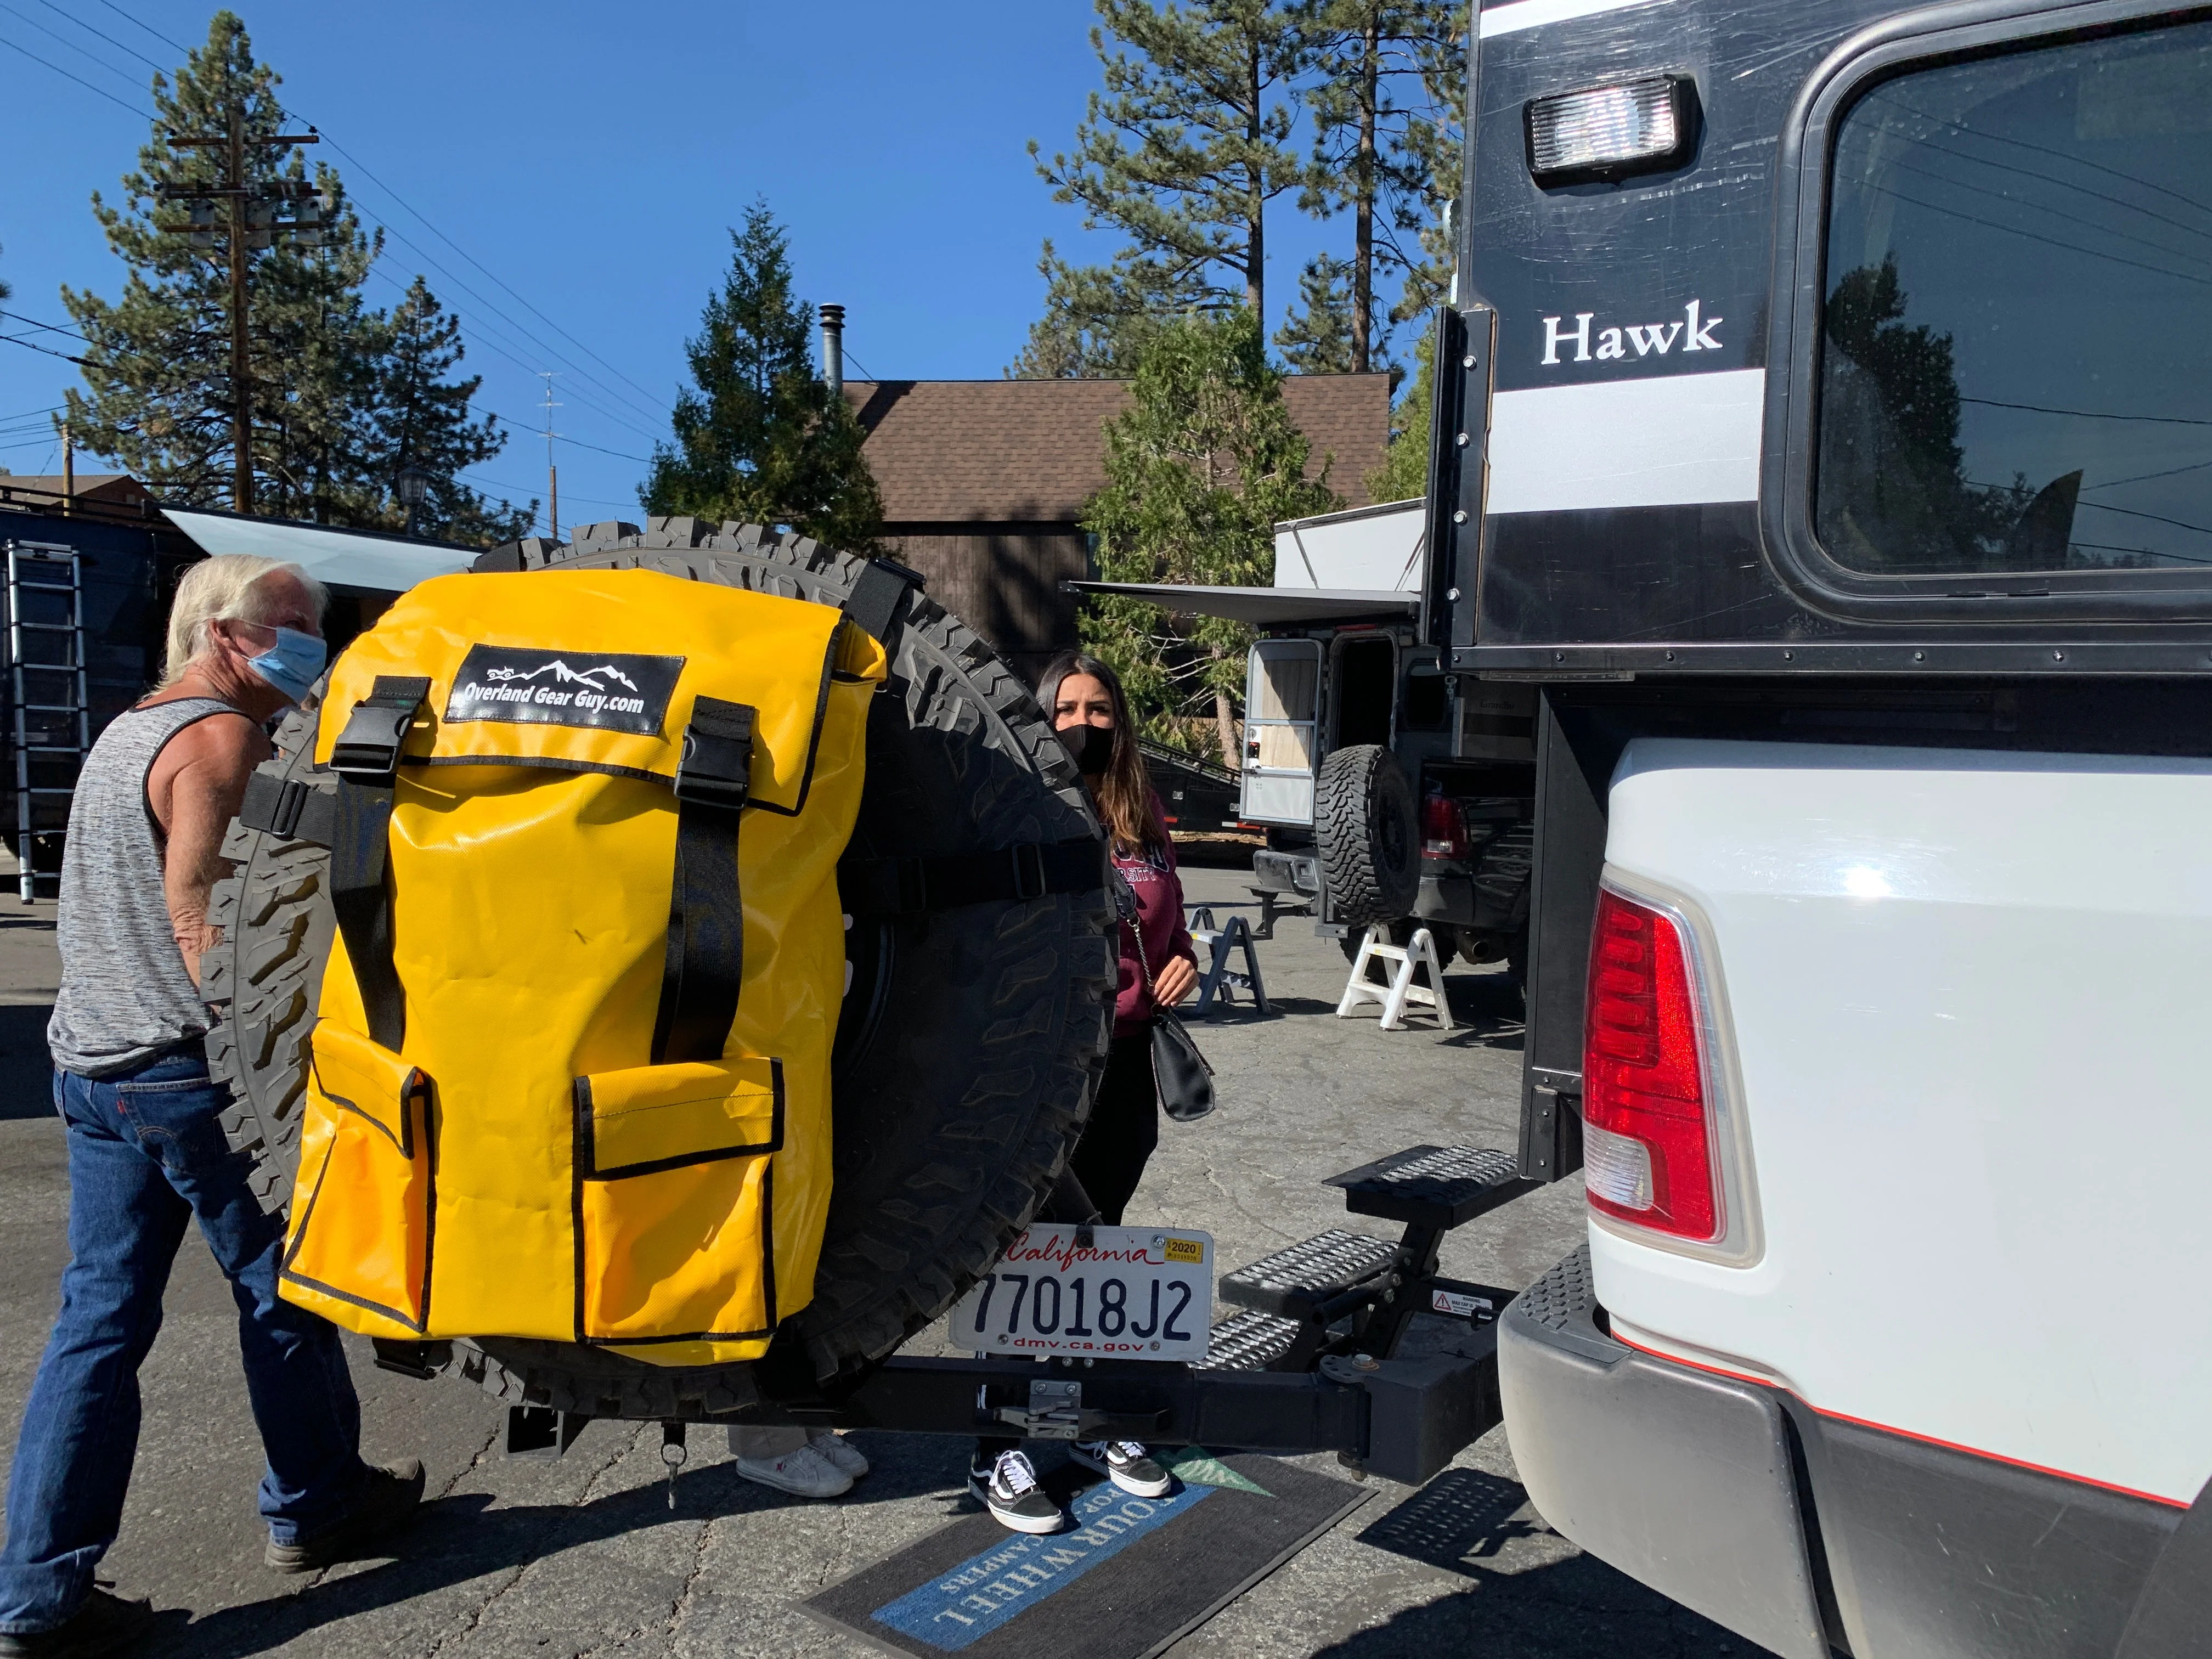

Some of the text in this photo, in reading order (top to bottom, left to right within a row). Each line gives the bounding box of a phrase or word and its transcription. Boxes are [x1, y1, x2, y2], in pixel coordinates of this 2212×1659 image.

[1541, 299, 1724, 365] Hawk
[464, 682, 645, 715] Overland Gear Guy.com
[1007, 1230, 1164, 1272] California
[1172, 1242, 1196, 1254] 2020
[974, 1273, 1192, 1341] 77018J2
[1014, 1338, 1144, 1353] dmv.ca.gov
[933, 1547, 1088, 1627] WHEEL
[939, 1536, 1045, 1593] CAMPERS
